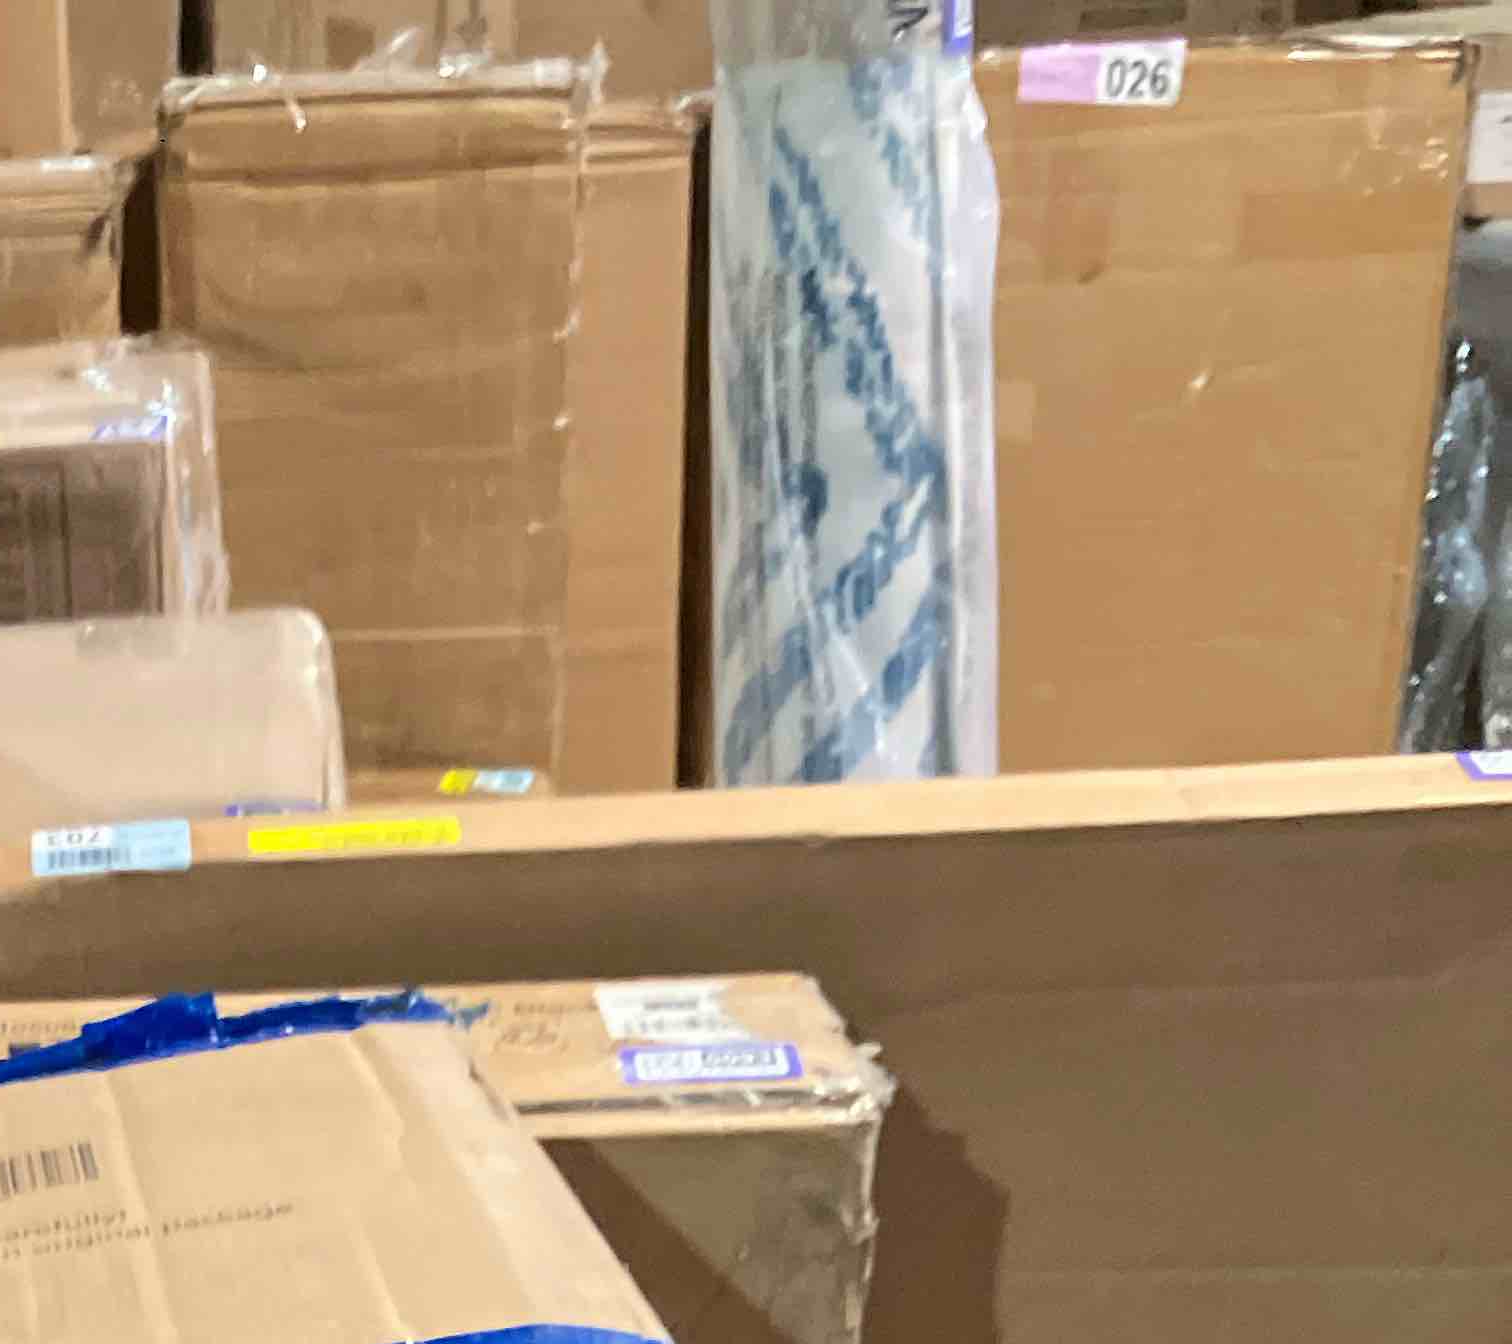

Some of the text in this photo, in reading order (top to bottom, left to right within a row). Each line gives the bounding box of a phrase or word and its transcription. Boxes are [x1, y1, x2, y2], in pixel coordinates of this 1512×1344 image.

[1105, 58, 1170, 99] 026
[33, 1224, 151, 1258] original
[162, 1202, 294, 1237] package
